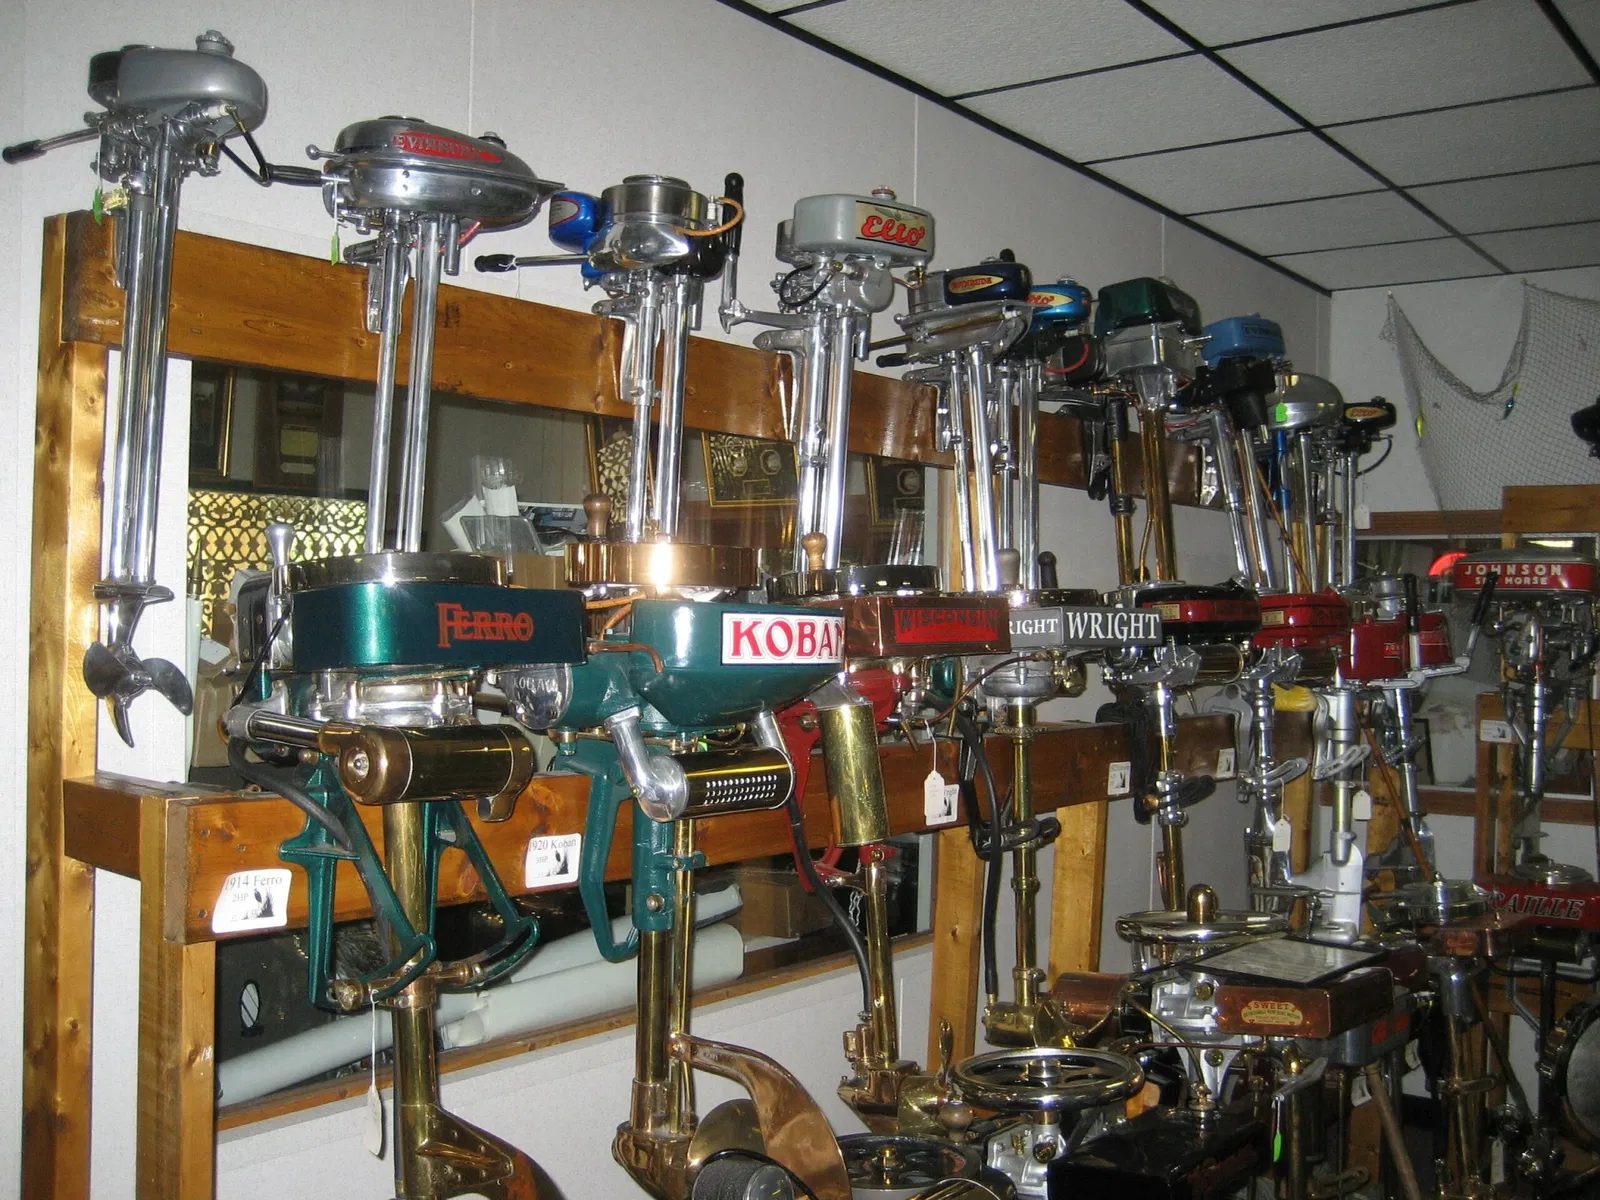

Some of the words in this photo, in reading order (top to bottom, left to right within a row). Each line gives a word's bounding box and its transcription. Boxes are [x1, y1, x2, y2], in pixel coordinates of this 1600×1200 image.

[861, 215, 925, 246] Elto
[1464, 564, 1562, 576] JOHNSON
[1505, 577, 1548, 585] HORSE
[894, 608, 1000, 633] WISCONSIN
[1009, 618, 1058, 636] RIGHT
[1066, 611, 1160, 642] WRIGHT
[529, 840, 549, 852] 1920
[551, 838, 577, 849] Koban
[225, 875, 249, 890] 1914
[254, 874, 282, 887] Ferro
[232, 892, 249, 902] 2HP
[1254, 1001, 1290, 1010] SWEET
